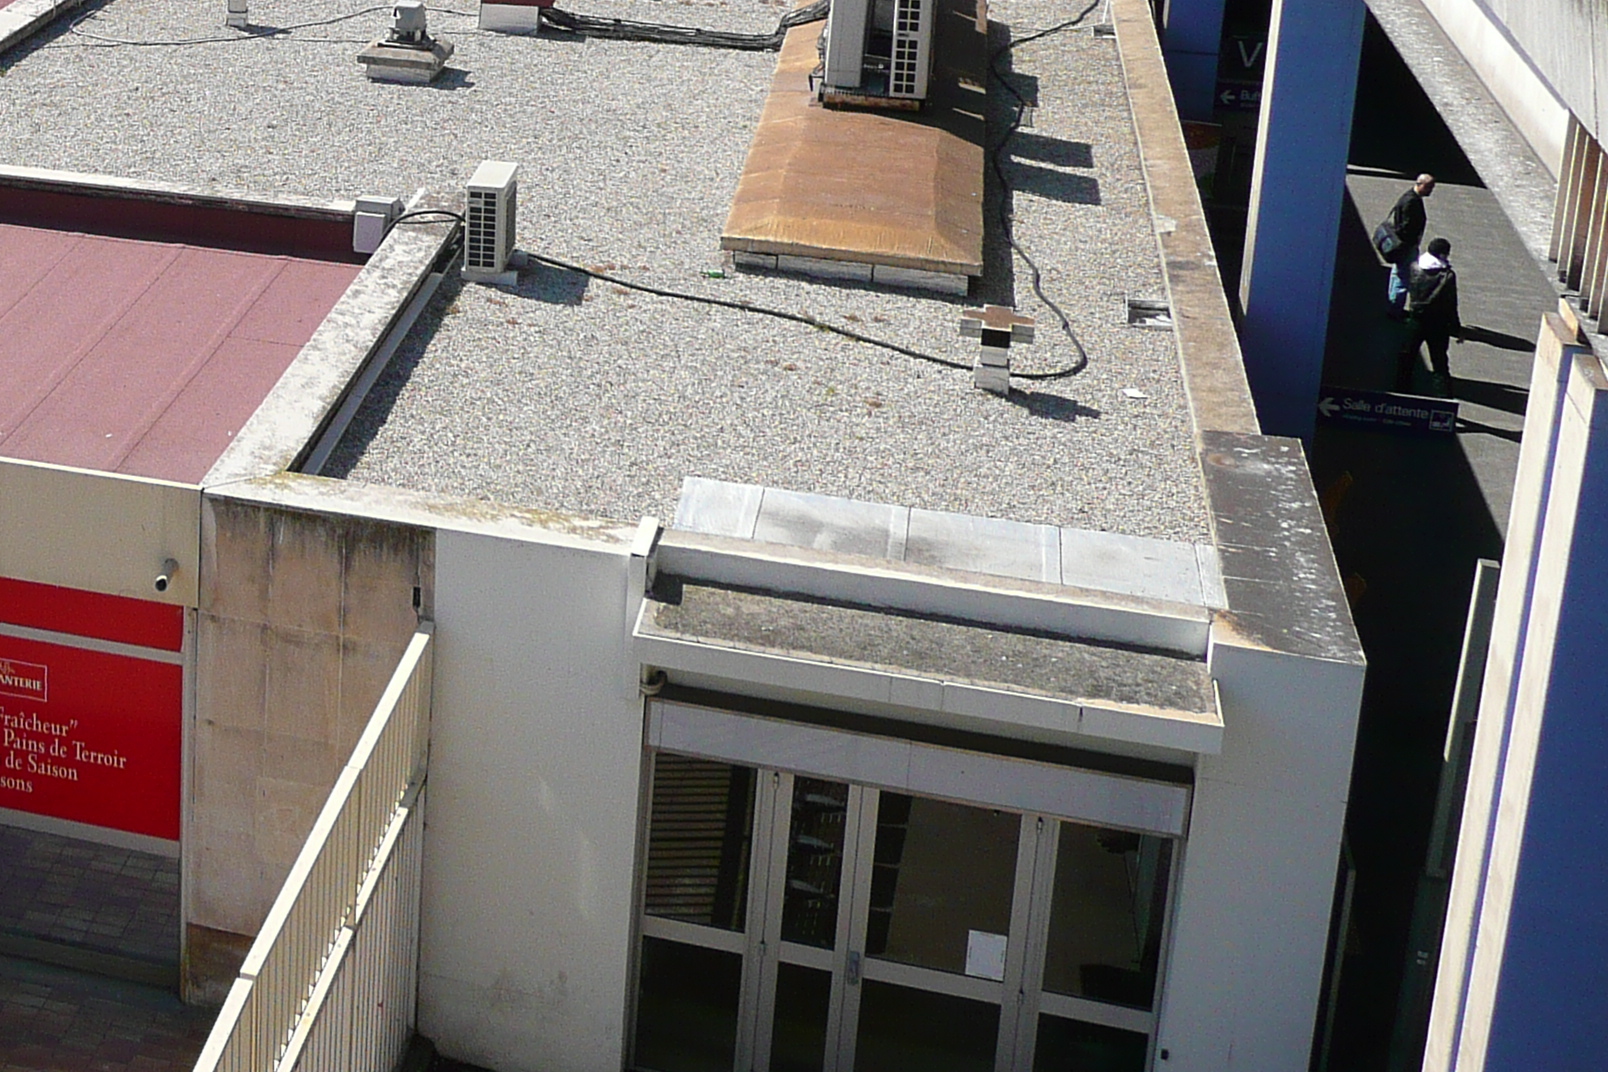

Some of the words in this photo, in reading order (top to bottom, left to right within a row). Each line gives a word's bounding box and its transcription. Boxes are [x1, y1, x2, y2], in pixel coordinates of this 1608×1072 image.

[1343, 397, 1371, 413] Salle
[1374, 402, 1430, 420] d'attente
[3, 729, 45, 754] Pains
[50, 738, 67, 758] de
[72, 740, 127, 769] Terroir
[5, 750, 23, 770] de
[27, 755, 78, 781] Saison
